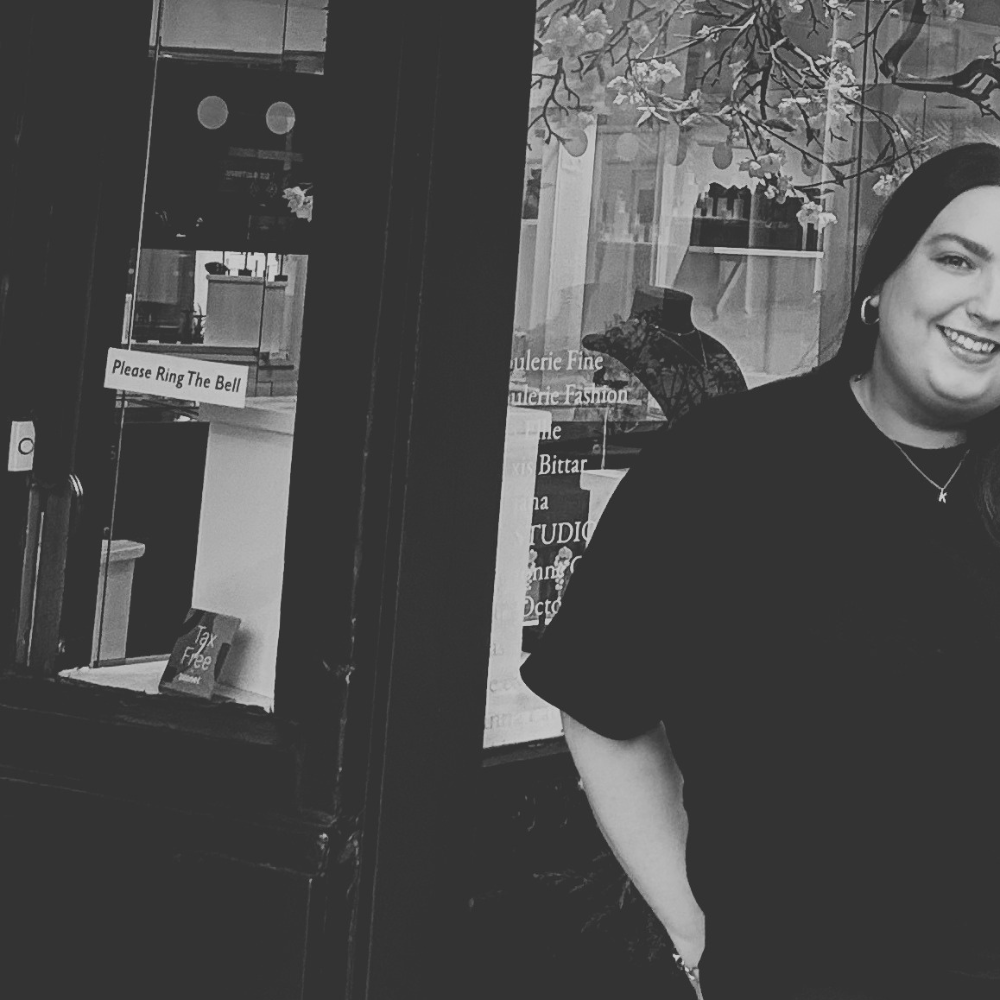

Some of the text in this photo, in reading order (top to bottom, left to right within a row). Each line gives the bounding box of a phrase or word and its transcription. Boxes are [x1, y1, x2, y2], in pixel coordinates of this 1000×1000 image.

[566, 349, 604, 371] Fine
[111, 359, 242, 393] Please Ring The Bell
[508, 382, 629, 406] ulerie Fashion
[538, 453, 588, 476] Bittar
[194, 624, 217, 649] Tax
[180, 646, 212, 671] Free
